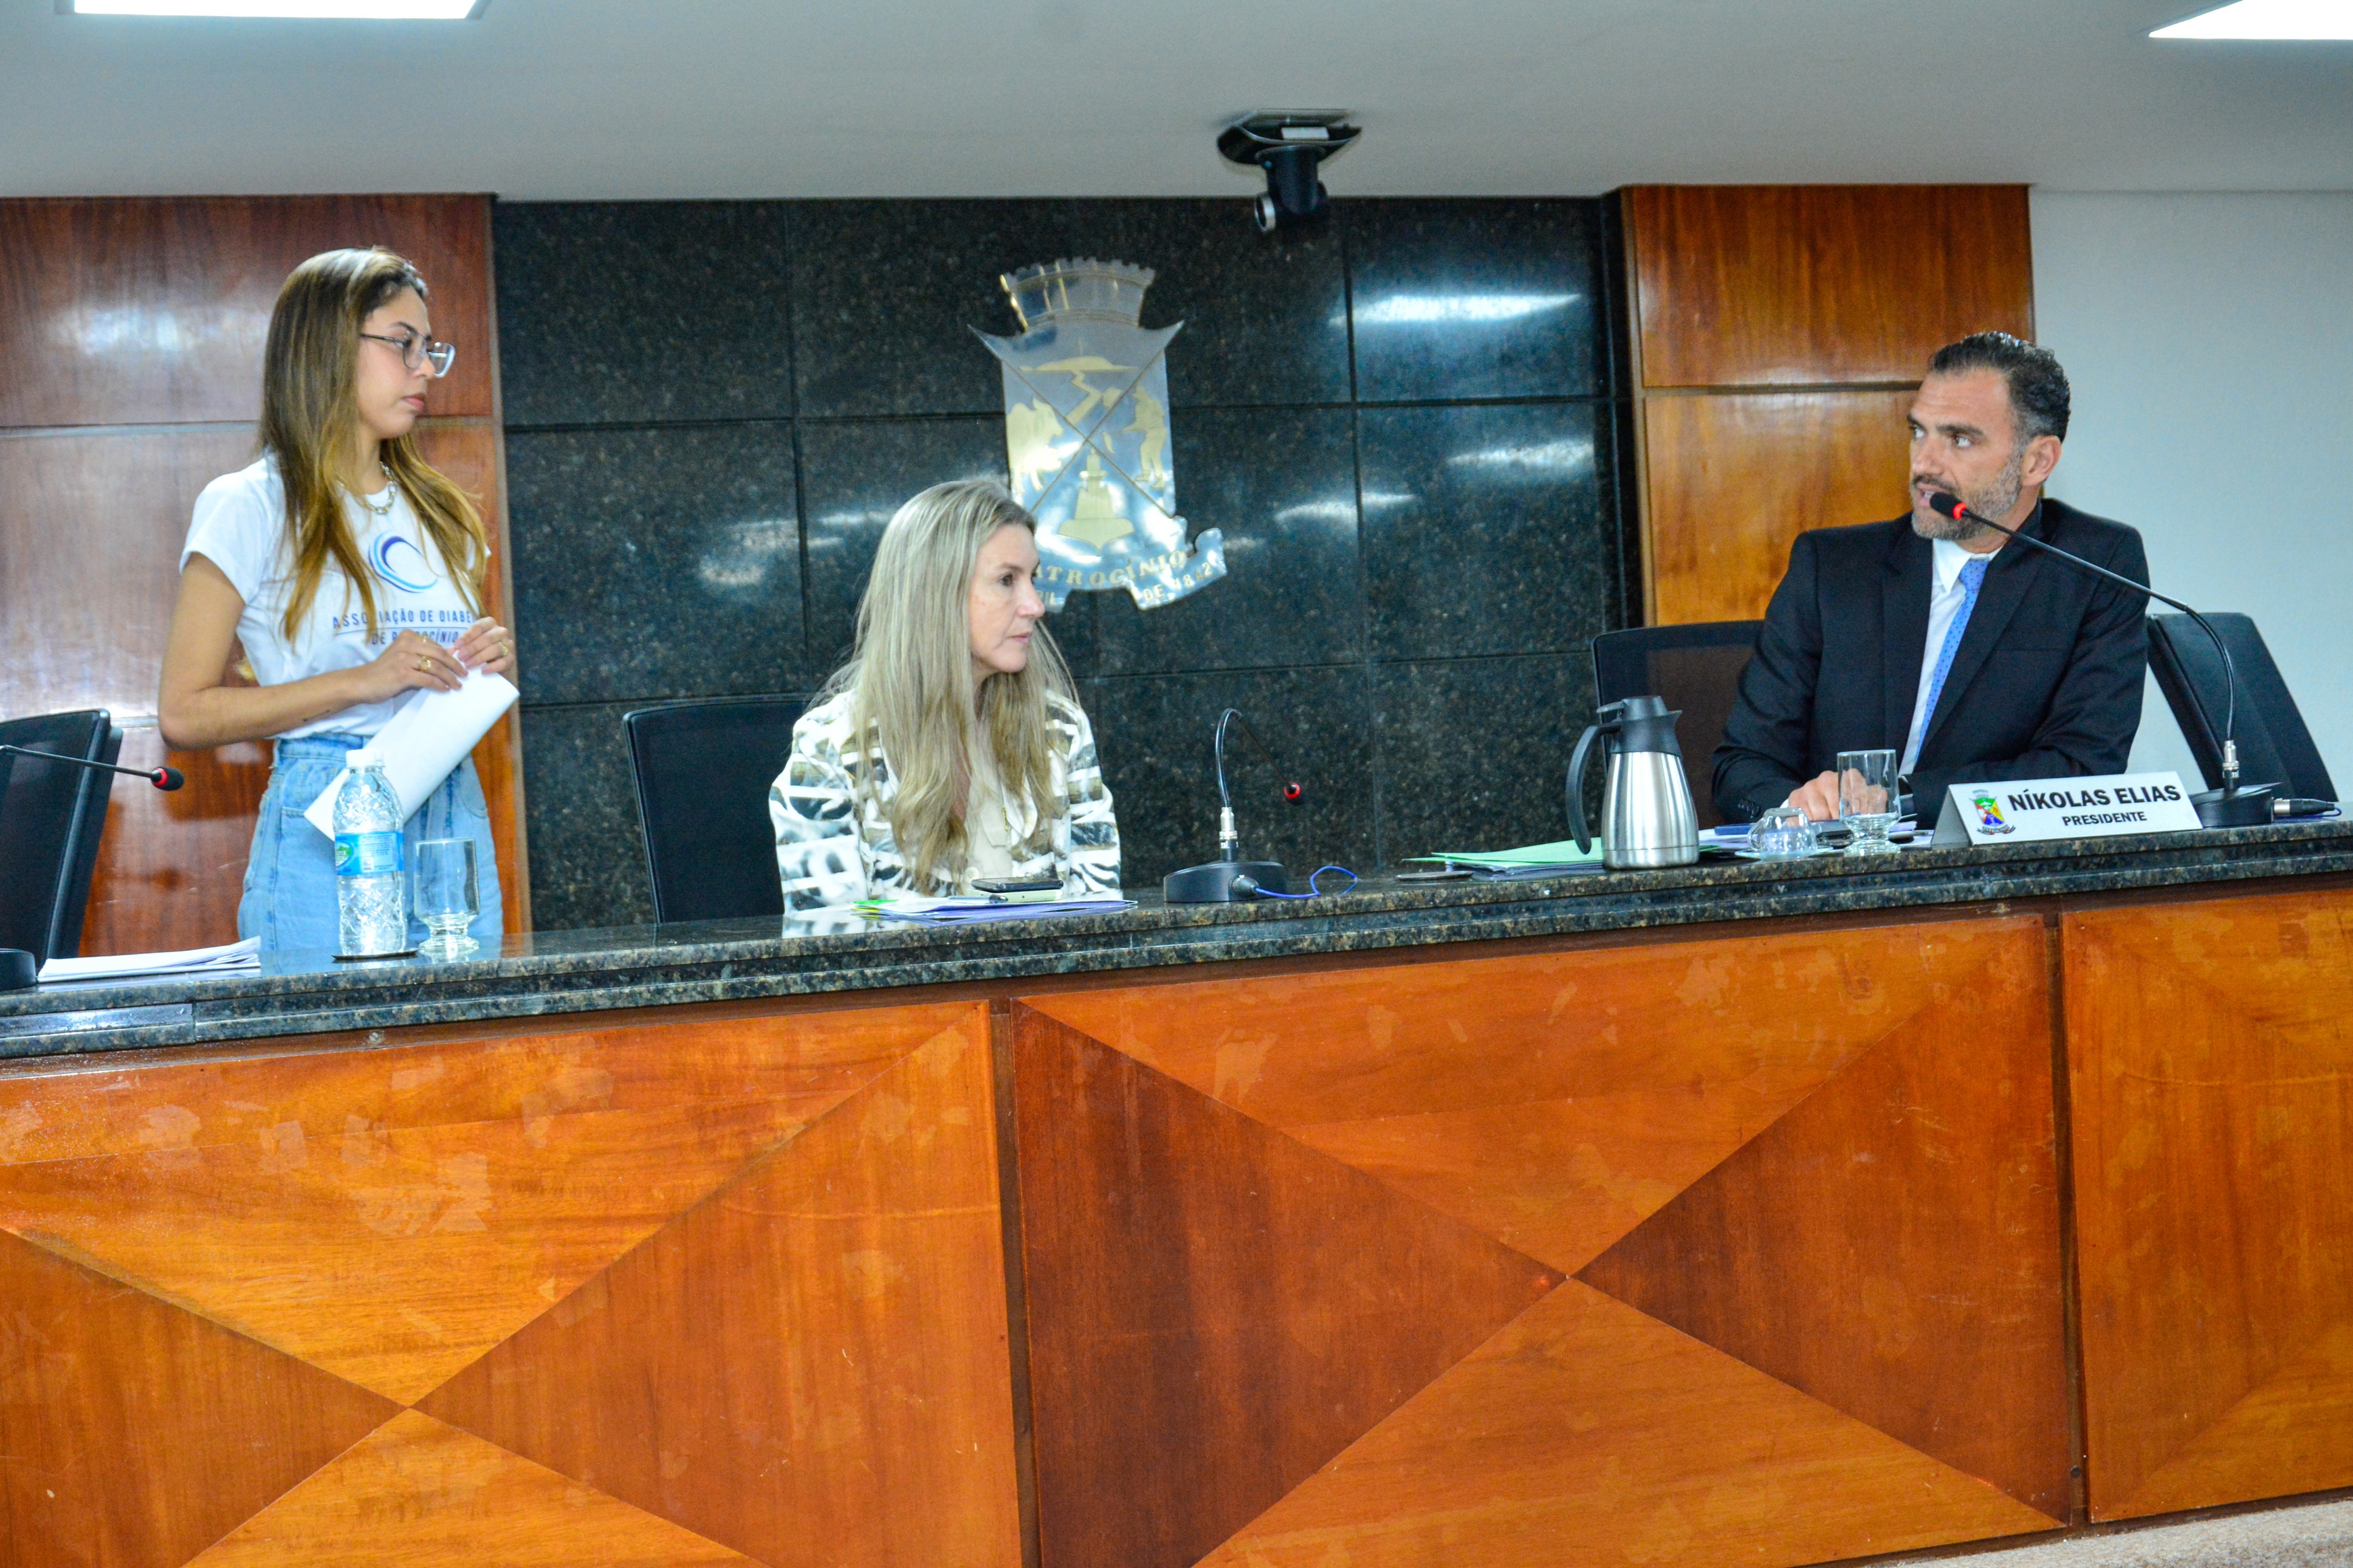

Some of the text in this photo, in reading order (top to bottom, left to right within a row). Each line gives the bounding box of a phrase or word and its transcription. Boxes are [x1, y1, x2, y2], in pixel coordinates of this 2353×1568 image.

[1035, 550, 1187, 586] ATROCÍNIO
[1142, 584, 1164, 603] DE
[332, 609, 475, 629] ASSOIAÇÃO DE DIABE
[371, 631, 385, 645] DE
[2007, 784, 2181, 811] NÍKOLAS ELIAS
[2062, 811, 2147, 826] PRESIDENTE
